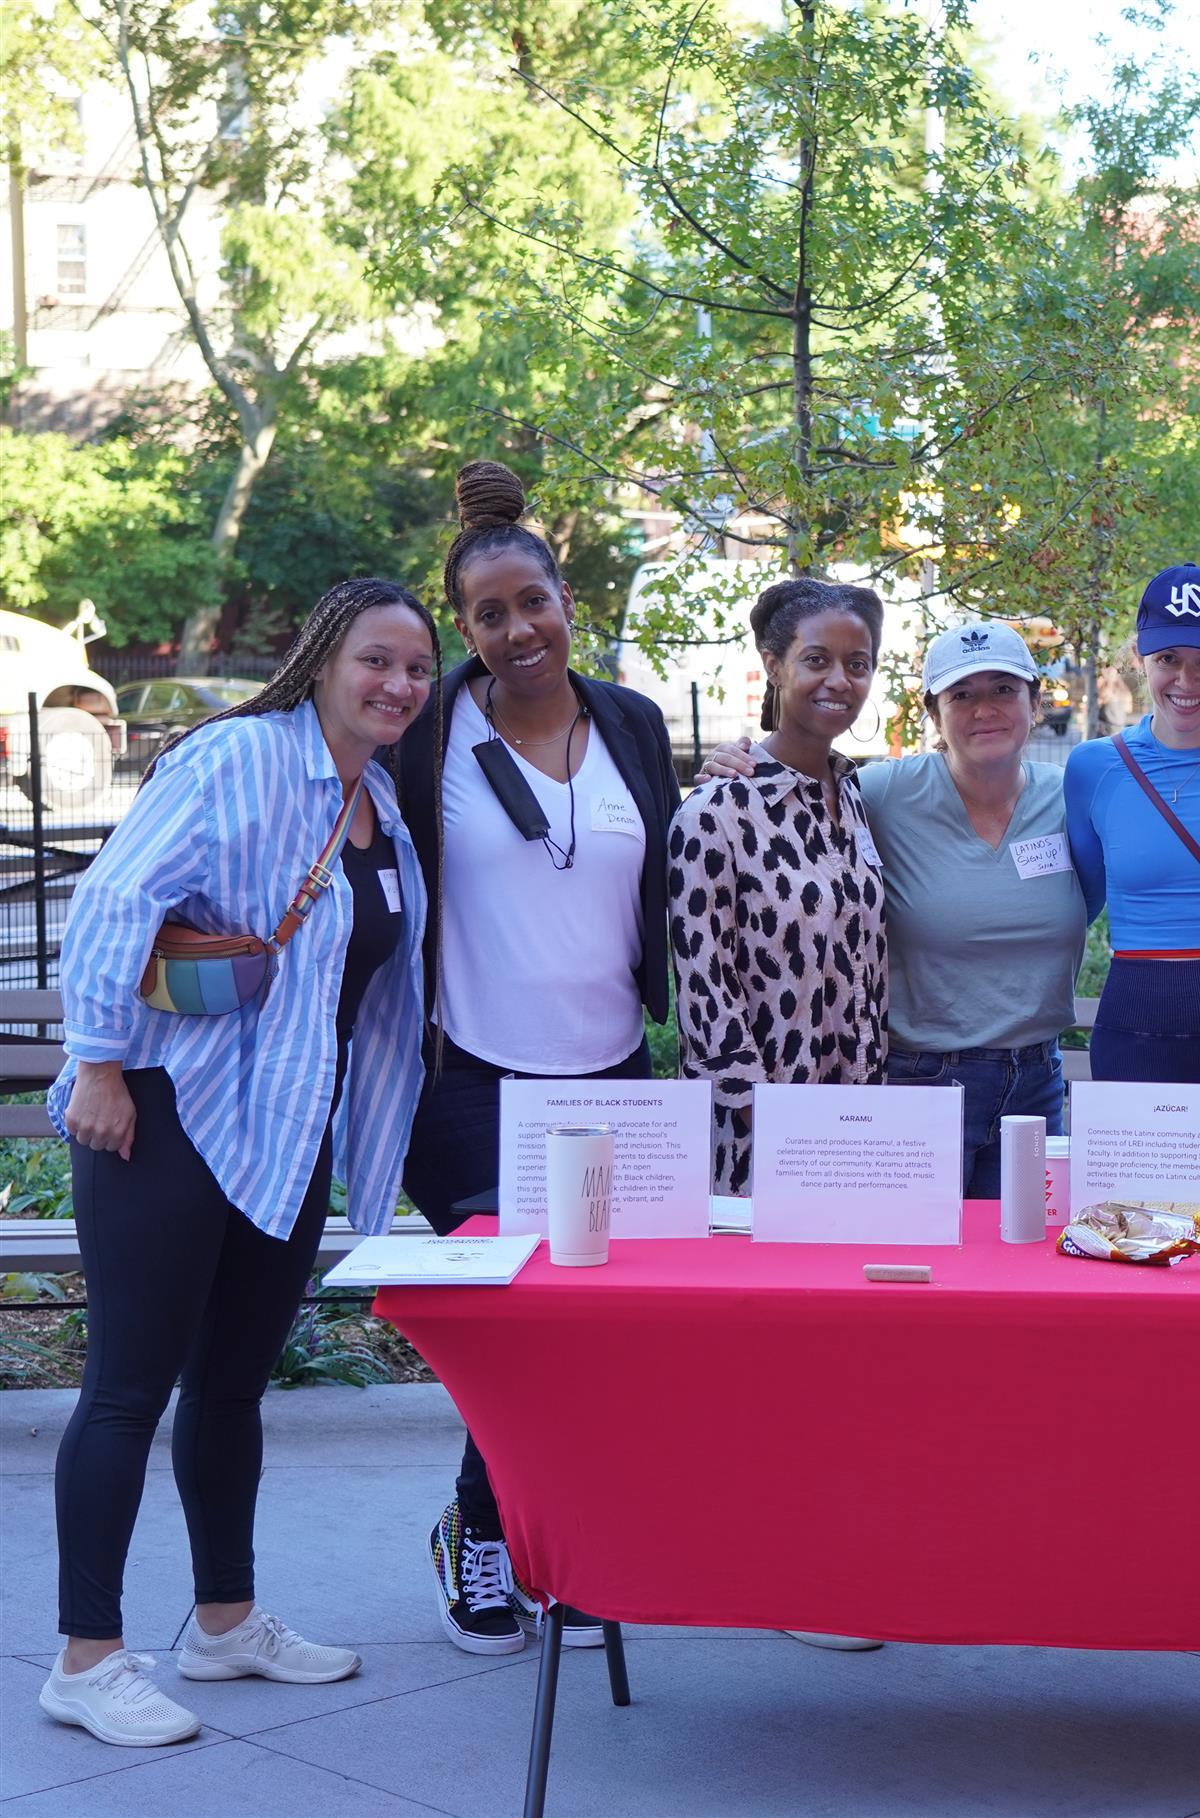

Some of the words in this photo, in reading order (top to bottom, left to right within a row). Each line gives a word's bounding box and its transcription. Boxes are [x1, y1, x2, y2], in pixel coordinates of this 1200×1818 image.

[962, 645, 991, 654] adidas
[518, 1132, 546, 1140] support
[1087, 1128, 1121, 1136] Connects
[1134, 1129, 1156, 1137] Latinx
[1156, 1130, 1197, 1140] community
[785, 1137, 813, 1145] Curates
[828, 1138, 862, 1147] produces
[1119, 1139, 1127, 1147] of
[1145, 1140, 1177, 1150] including
[817, 1149, 862, 1158] representing
[875, 1149, 905, 1157] cultures
[1121, 1150, 1150, 1158] addition
[1159, 1152, 1198, 1161] supporting
[779, 1159, 809, 1168] diversity
[1086, 1160, 1119, 1170] language
[1120, 1161, 1159, 1171] proficiency,
[1119, 1171, 1133, 1179] that
[823, 1181, 842, 1190] party
[517, 1196, 543, 1204] pursuit
[622, 1195, 649, 1203] vibrant,
[589, 1199, 610, 1232] BEA
